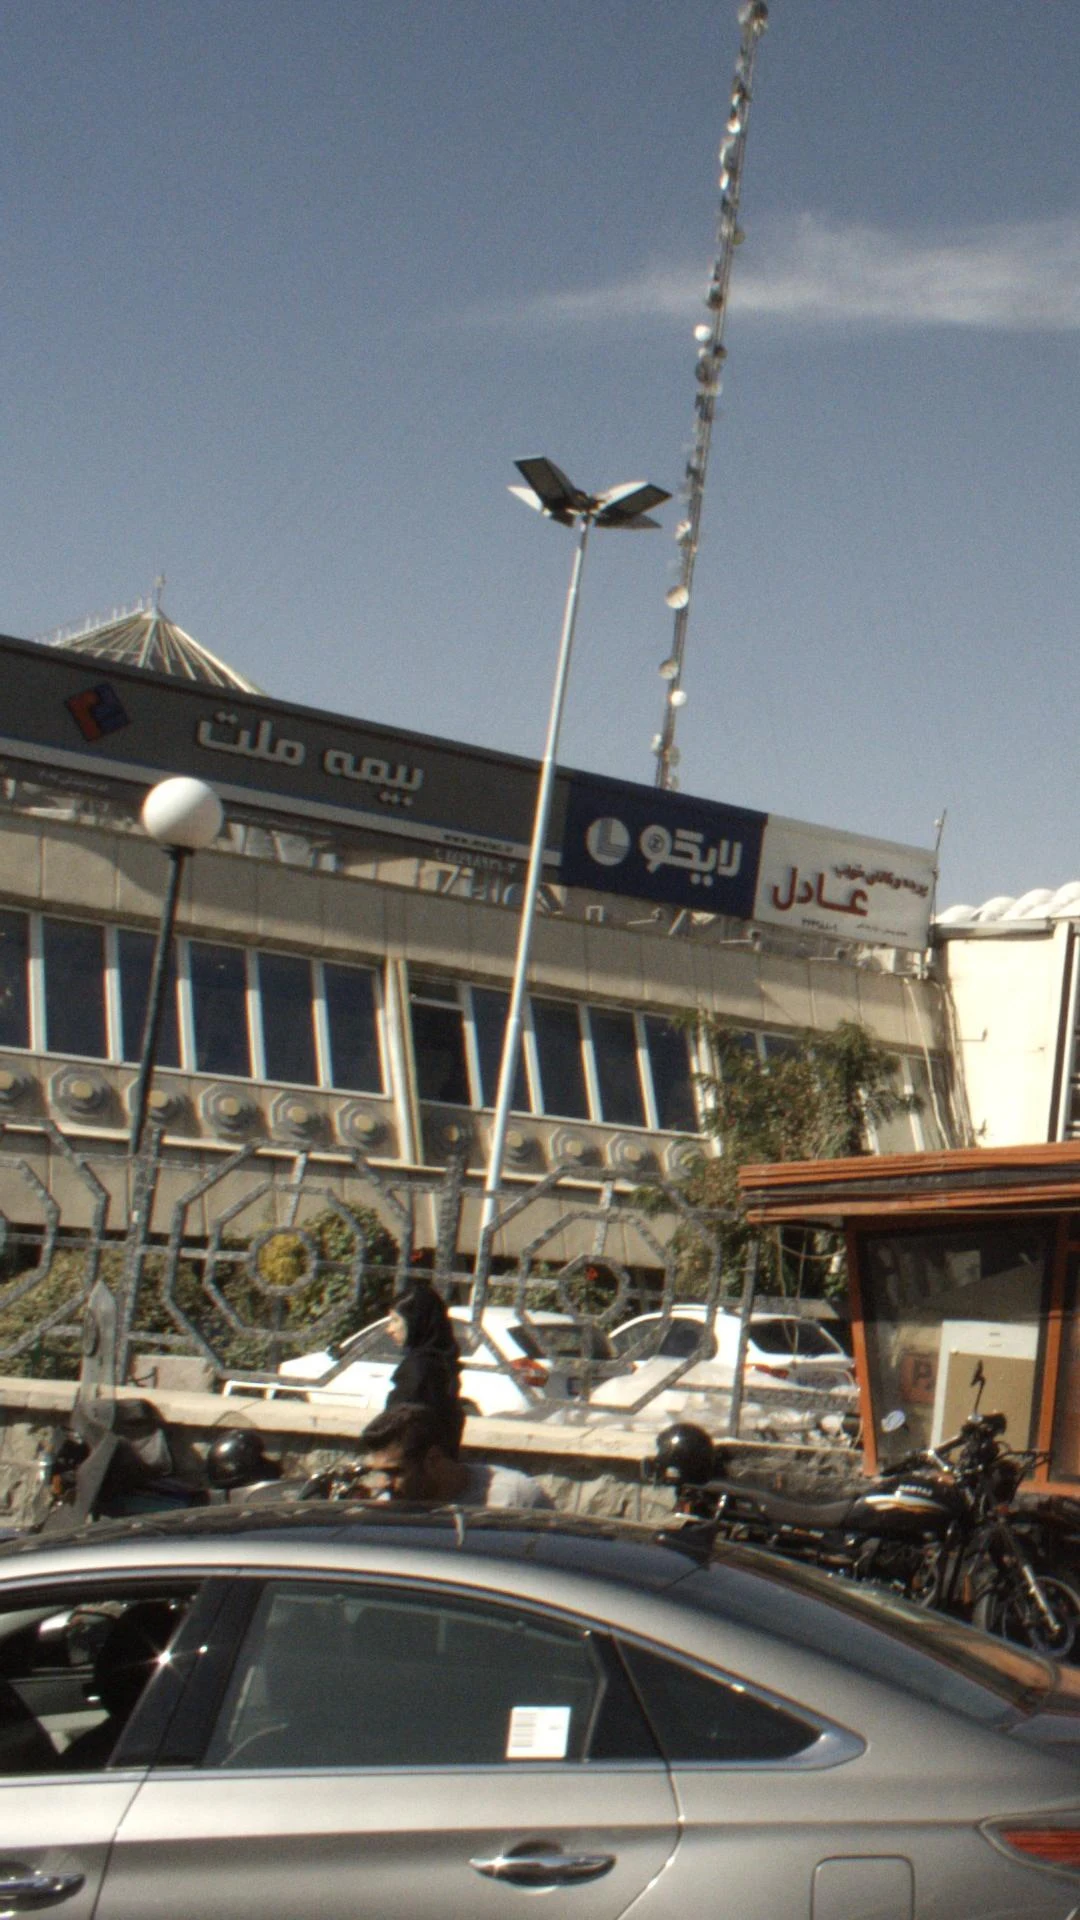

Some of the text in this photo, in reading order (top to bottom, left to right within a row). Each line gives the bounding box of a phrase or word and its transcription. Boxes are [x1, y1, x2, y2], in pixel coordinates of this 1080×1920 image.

[197, 710, 424, 806] بیمه ملت
[640, 824, 742, 887] لایکو
[772, 866, 869, 917] عادل
